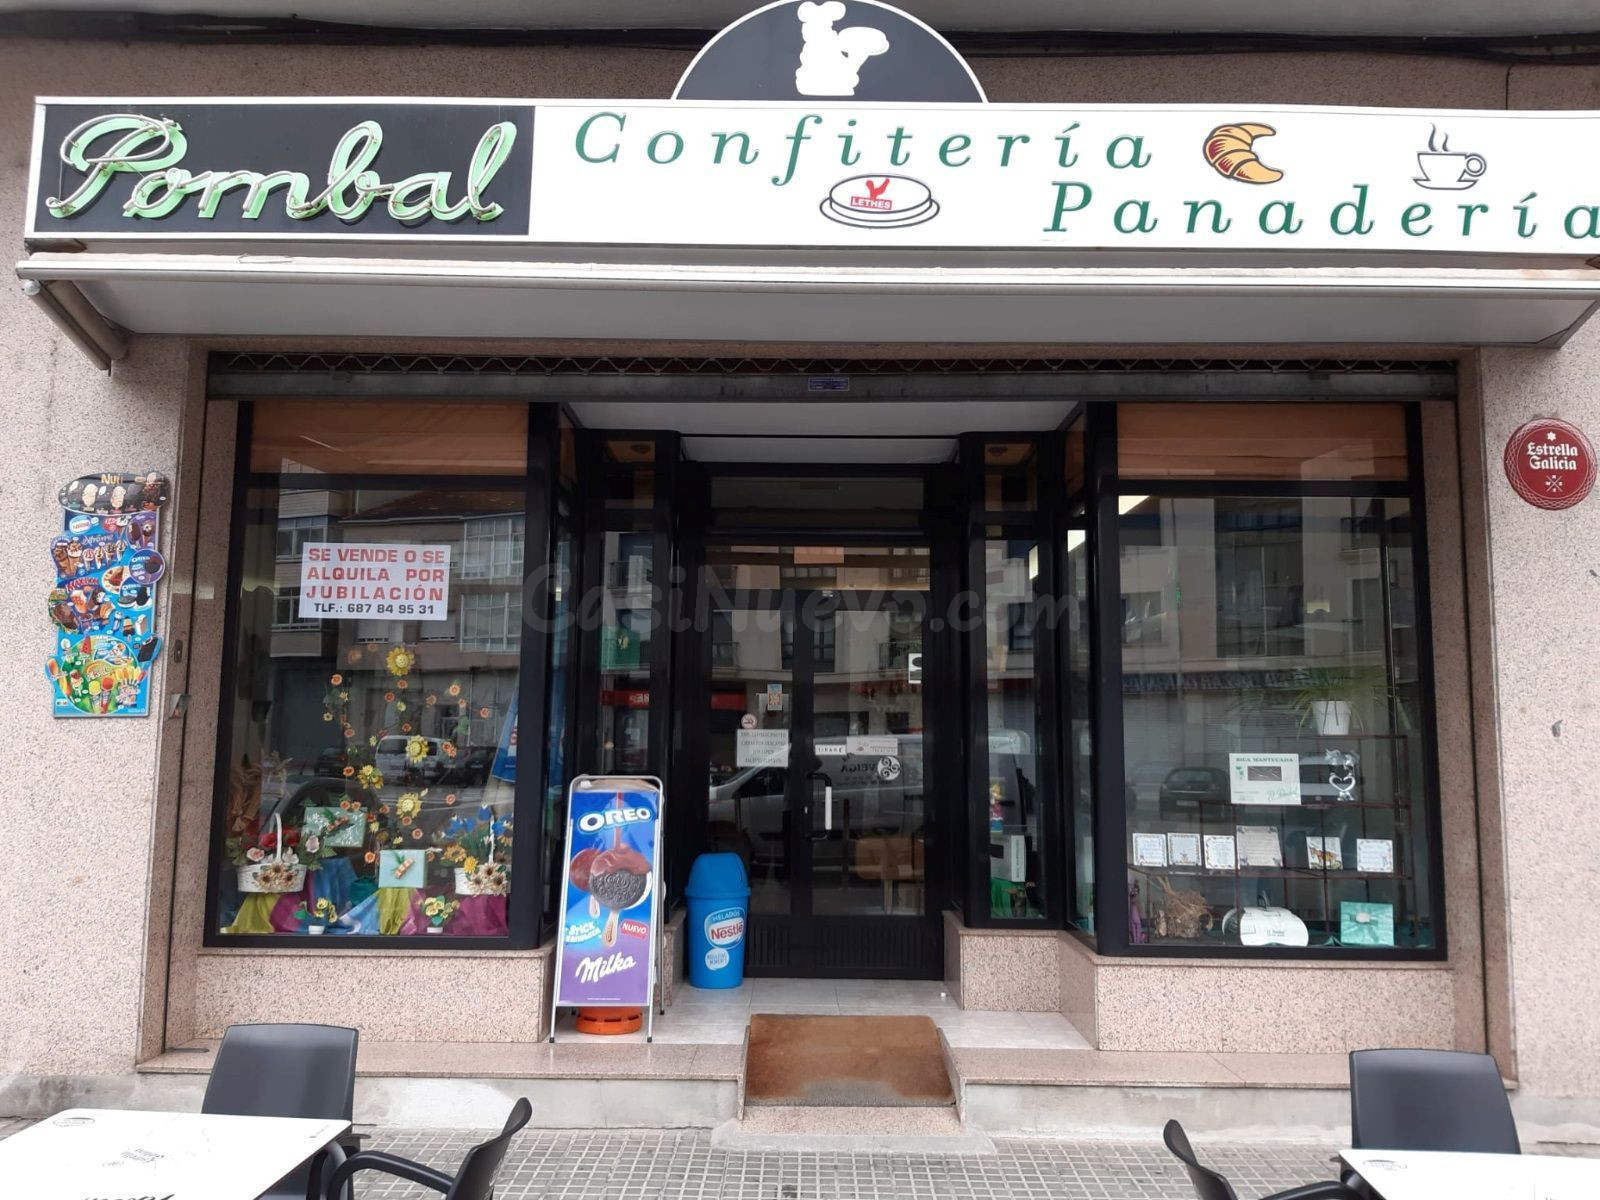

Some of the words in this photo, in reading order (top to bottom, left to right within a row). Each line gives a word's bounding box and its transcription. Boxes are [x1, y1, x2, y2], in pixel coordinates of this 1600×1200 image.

[575, 111, 1152, 187] Confitería
[46, 113, 505, 222] Pombal
[851, 197, 891, 210] LETHES
[1043, 180, 1600, 240] Panadería
[1526, 441, 1579, 456] Estrella
[1529, 456, 1577, 471] Galicia
[308, 548, 331, 562] SE
[337, 549, 398, 563] VENDE
[404, 550, 417, 563] O
[422, 550, 445, 564] SE
[307, 567, 390, 581] ALQUILA
[406, 568, 444, 582] POR
[306, 584, 443, 601] JUBILACIÓN
[347, 603, 372, 613] 687
[377, 604, 393, 614] 84
[398, 605, 414, 614] 95
[418, 605, 434, 615] 31
[579, 807, 651, 832] OREO
[622, 922, 648, 935] NUEVO
[574, 951, 637, 984] Milka
